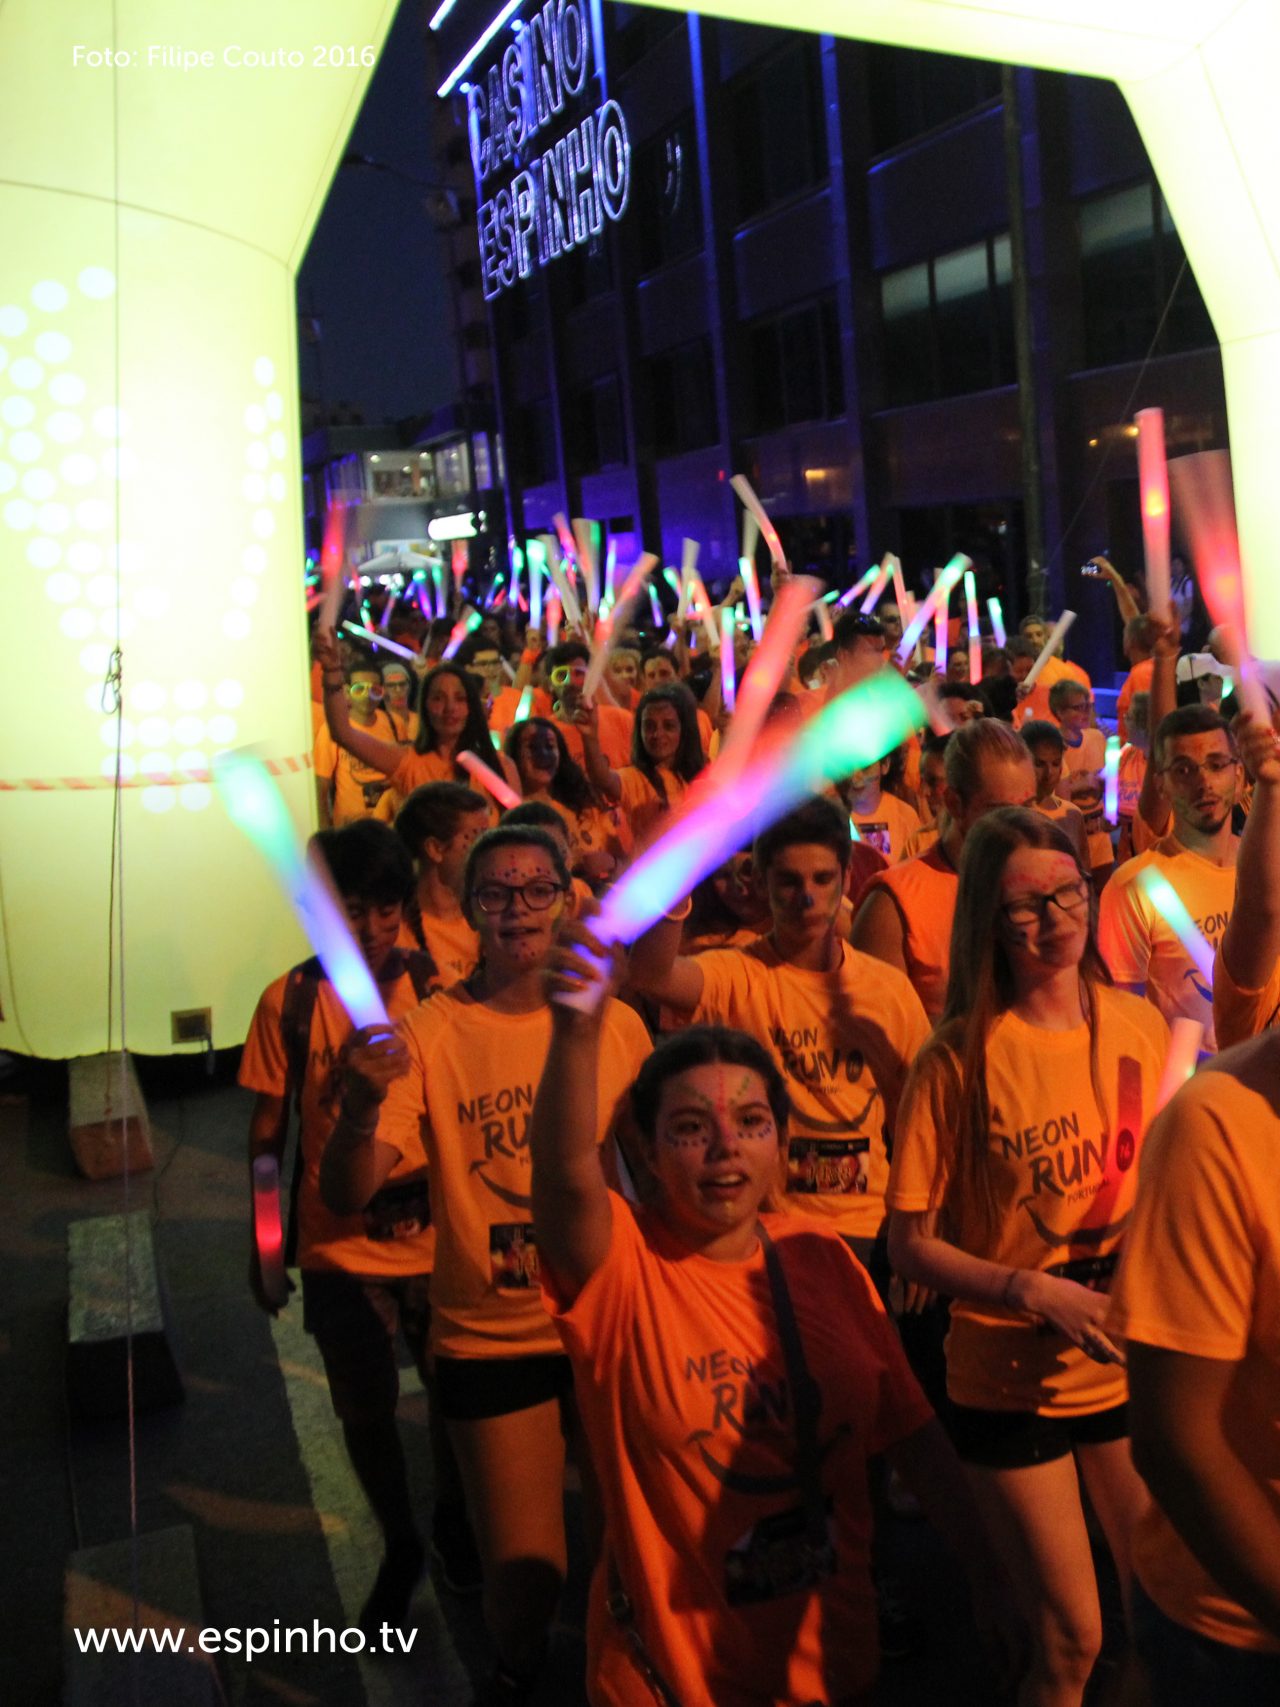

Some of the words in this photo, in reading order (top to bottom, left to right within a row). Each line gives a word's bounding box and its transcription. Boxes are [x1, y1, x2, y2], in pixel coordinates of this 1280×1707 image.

[478, 99, 630, 301] ESPINHO
[481, 1111, 534, 1160] RU
[1001, 1111, 1080, 1160] NEON
[1028, 1132, 1110, 1197] RUN
